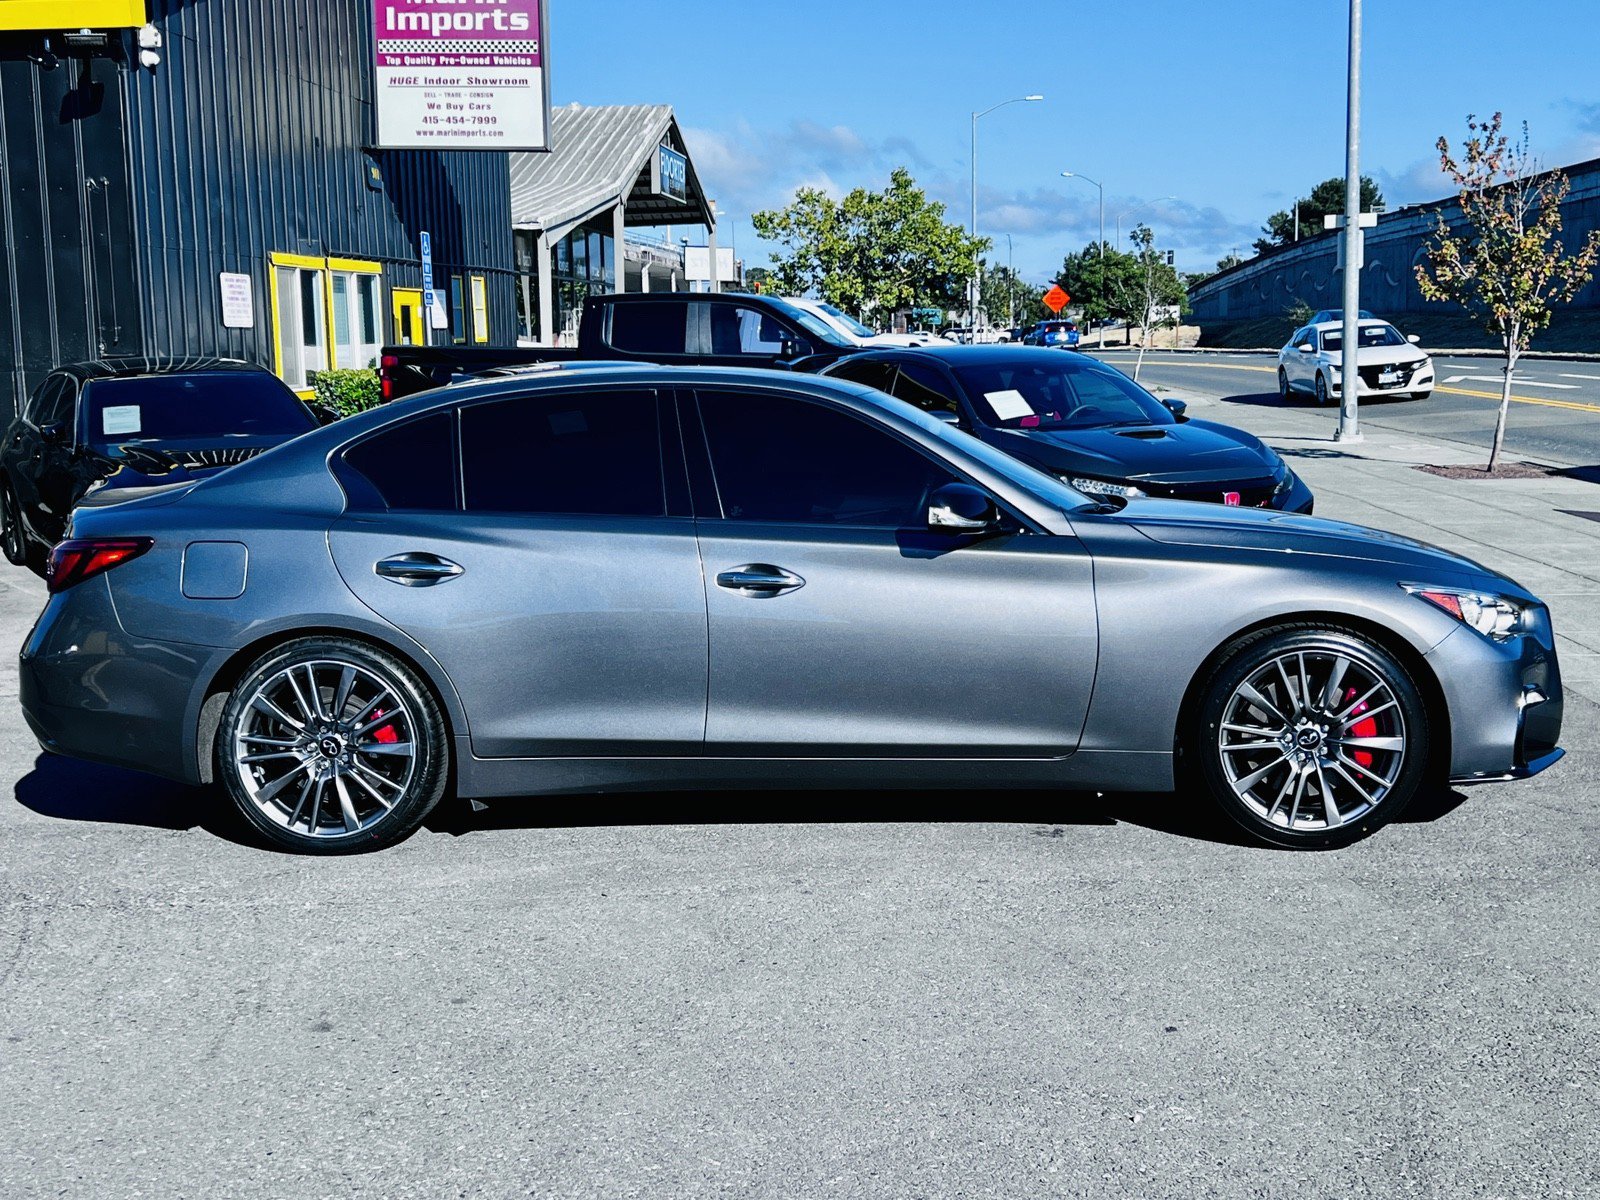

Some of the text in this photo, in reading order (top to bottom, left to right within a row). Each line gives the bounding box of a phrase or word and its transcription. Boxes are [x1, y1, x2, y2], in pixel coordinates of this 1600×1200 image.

[385, 6, 529, 37] Imports
[385, 55, 532, 66] Top Quality Pre-Owned Vehicles
[389, 76, 529, 85] HUGE Indoor Showroom
[427, 102, 492, 111] We Buy Cars
[422, 116, 497, 125] 415-454-7999
[416, 129, 504, 138] www.marinimports.com
